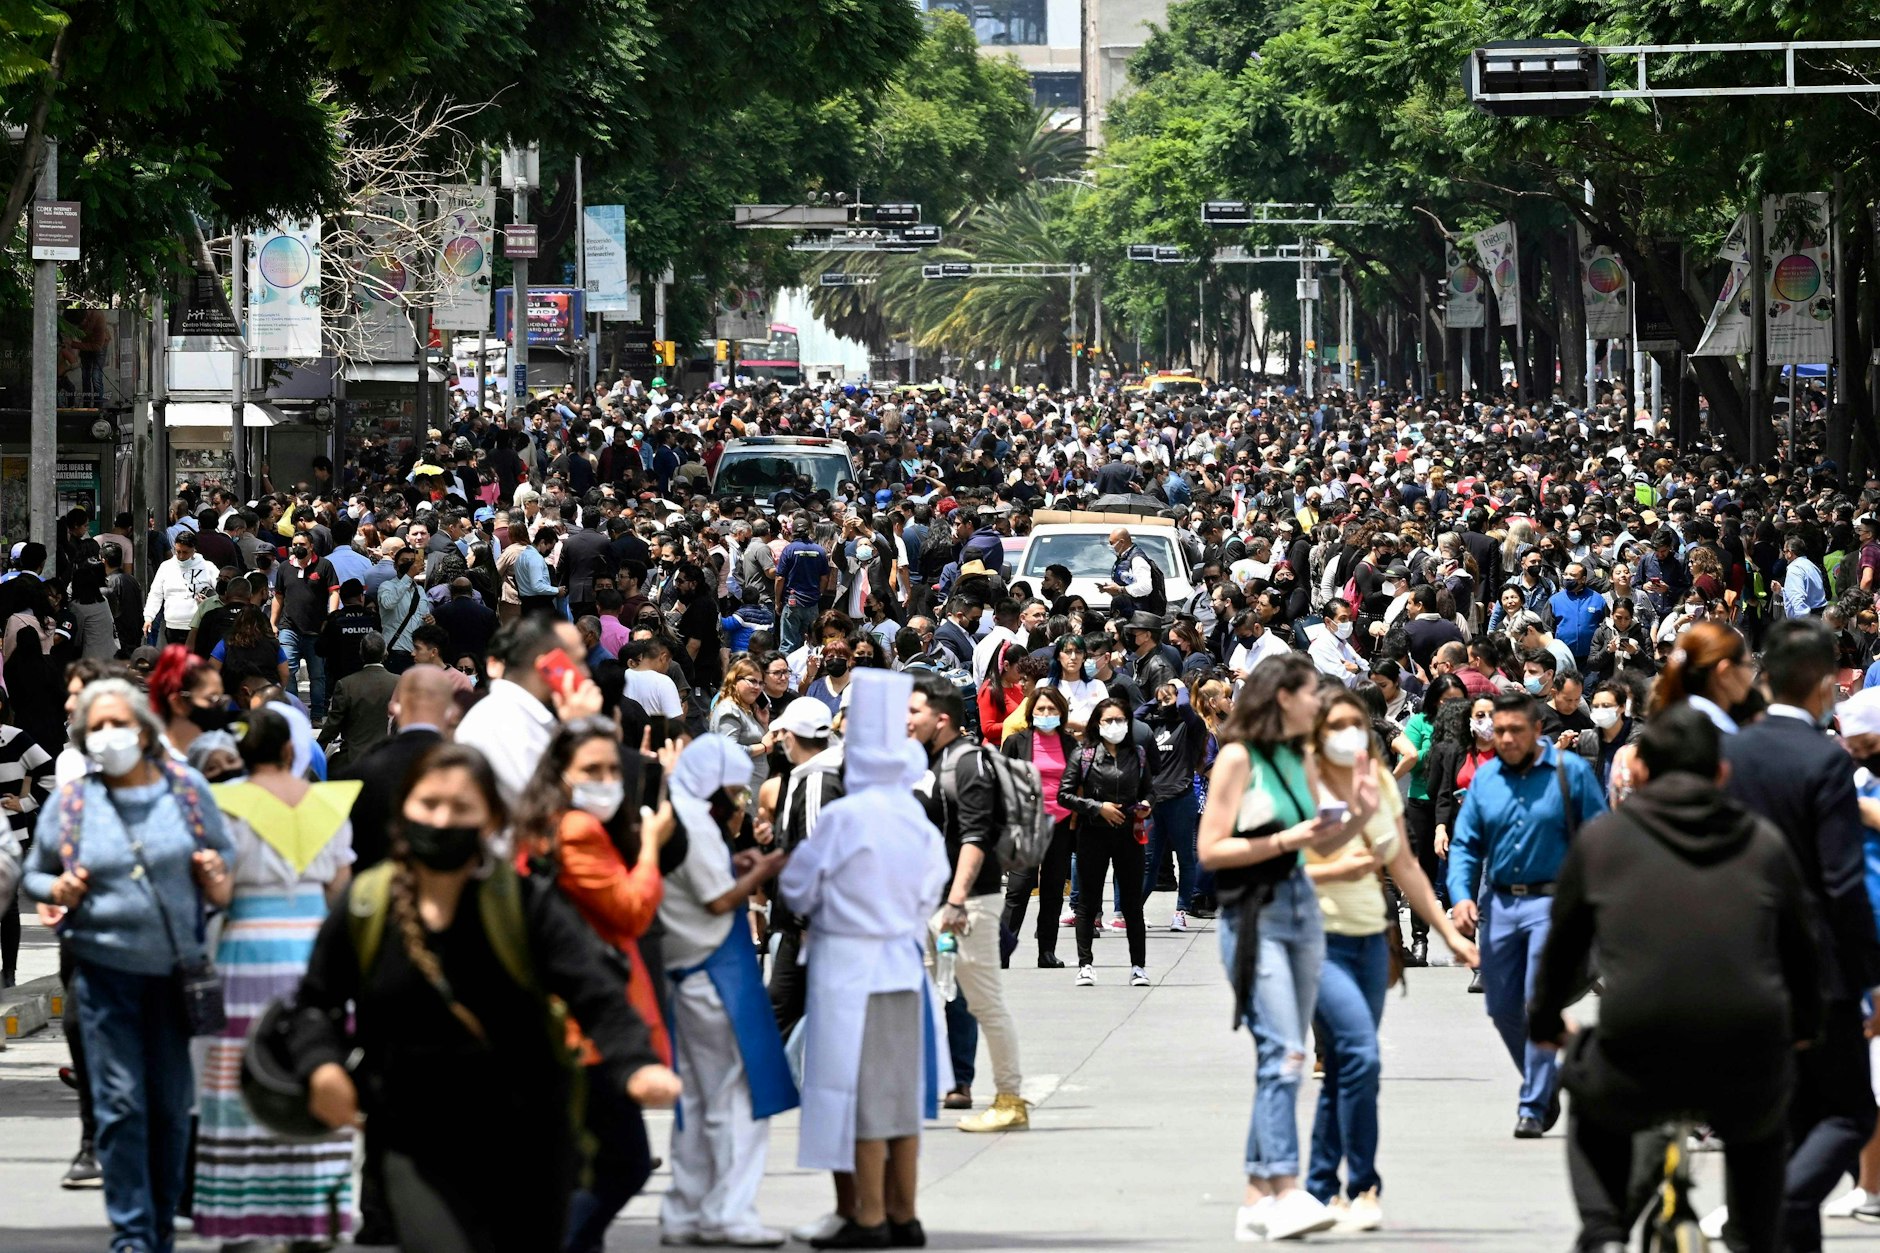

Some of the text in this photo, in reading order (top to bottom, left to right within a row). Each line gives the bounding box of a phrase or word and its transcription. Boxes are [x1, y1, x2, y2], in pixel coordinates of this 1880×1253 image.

[69, 463, 85, 471] IDEAS
[85, 463, 92, 471] DE
[342, 626, 374, 634] POLICIA
